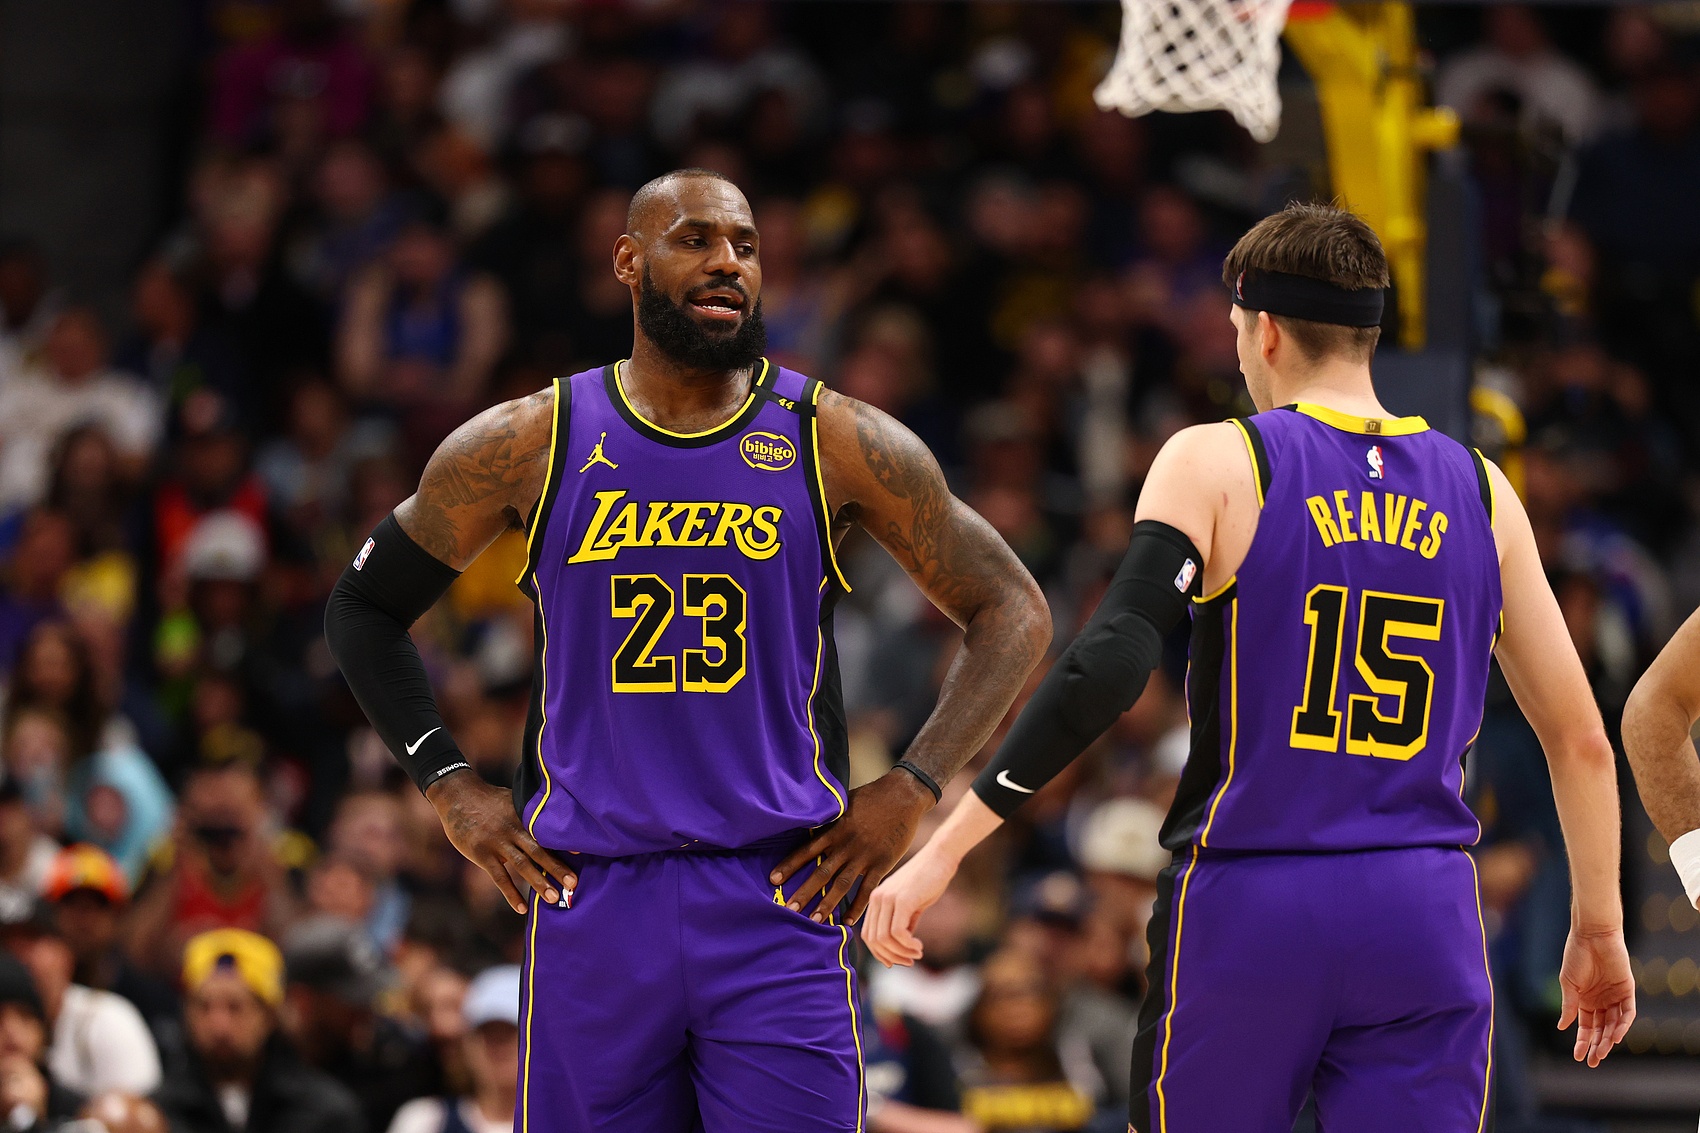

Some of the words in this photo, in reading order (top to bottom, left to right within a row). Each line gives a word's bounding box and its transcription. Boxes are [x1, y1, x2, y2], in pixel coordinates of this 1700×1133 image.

[778, 398, 795, 410] 44
[745, 440, 793, 461] bibigo
[567, 489, 783, 565] LAKERS
[1306, 490, 1448, 560] REAVES
[611, 573, 747, 693] 23
[1289, 583, 1445, 761] 15
